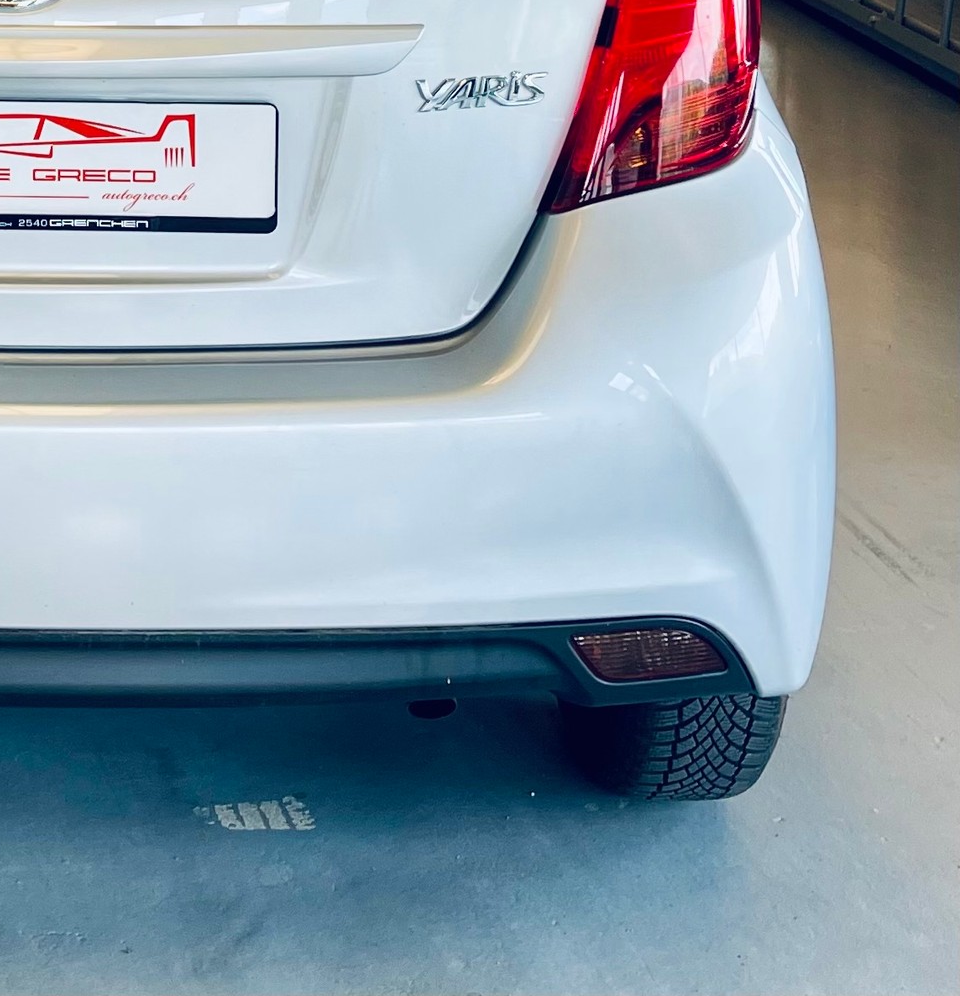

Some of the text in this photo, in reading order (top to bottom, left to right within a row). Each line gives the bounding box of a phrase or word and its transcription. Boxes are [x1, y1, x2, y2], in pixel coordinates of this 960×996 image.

[32, 168, 157, 183] GRECO
[101, 182, 195, 212] autogreco.ch
[18, 218, 48, 228] 2540
[49, 219, 149, 229] GRENCHEN
